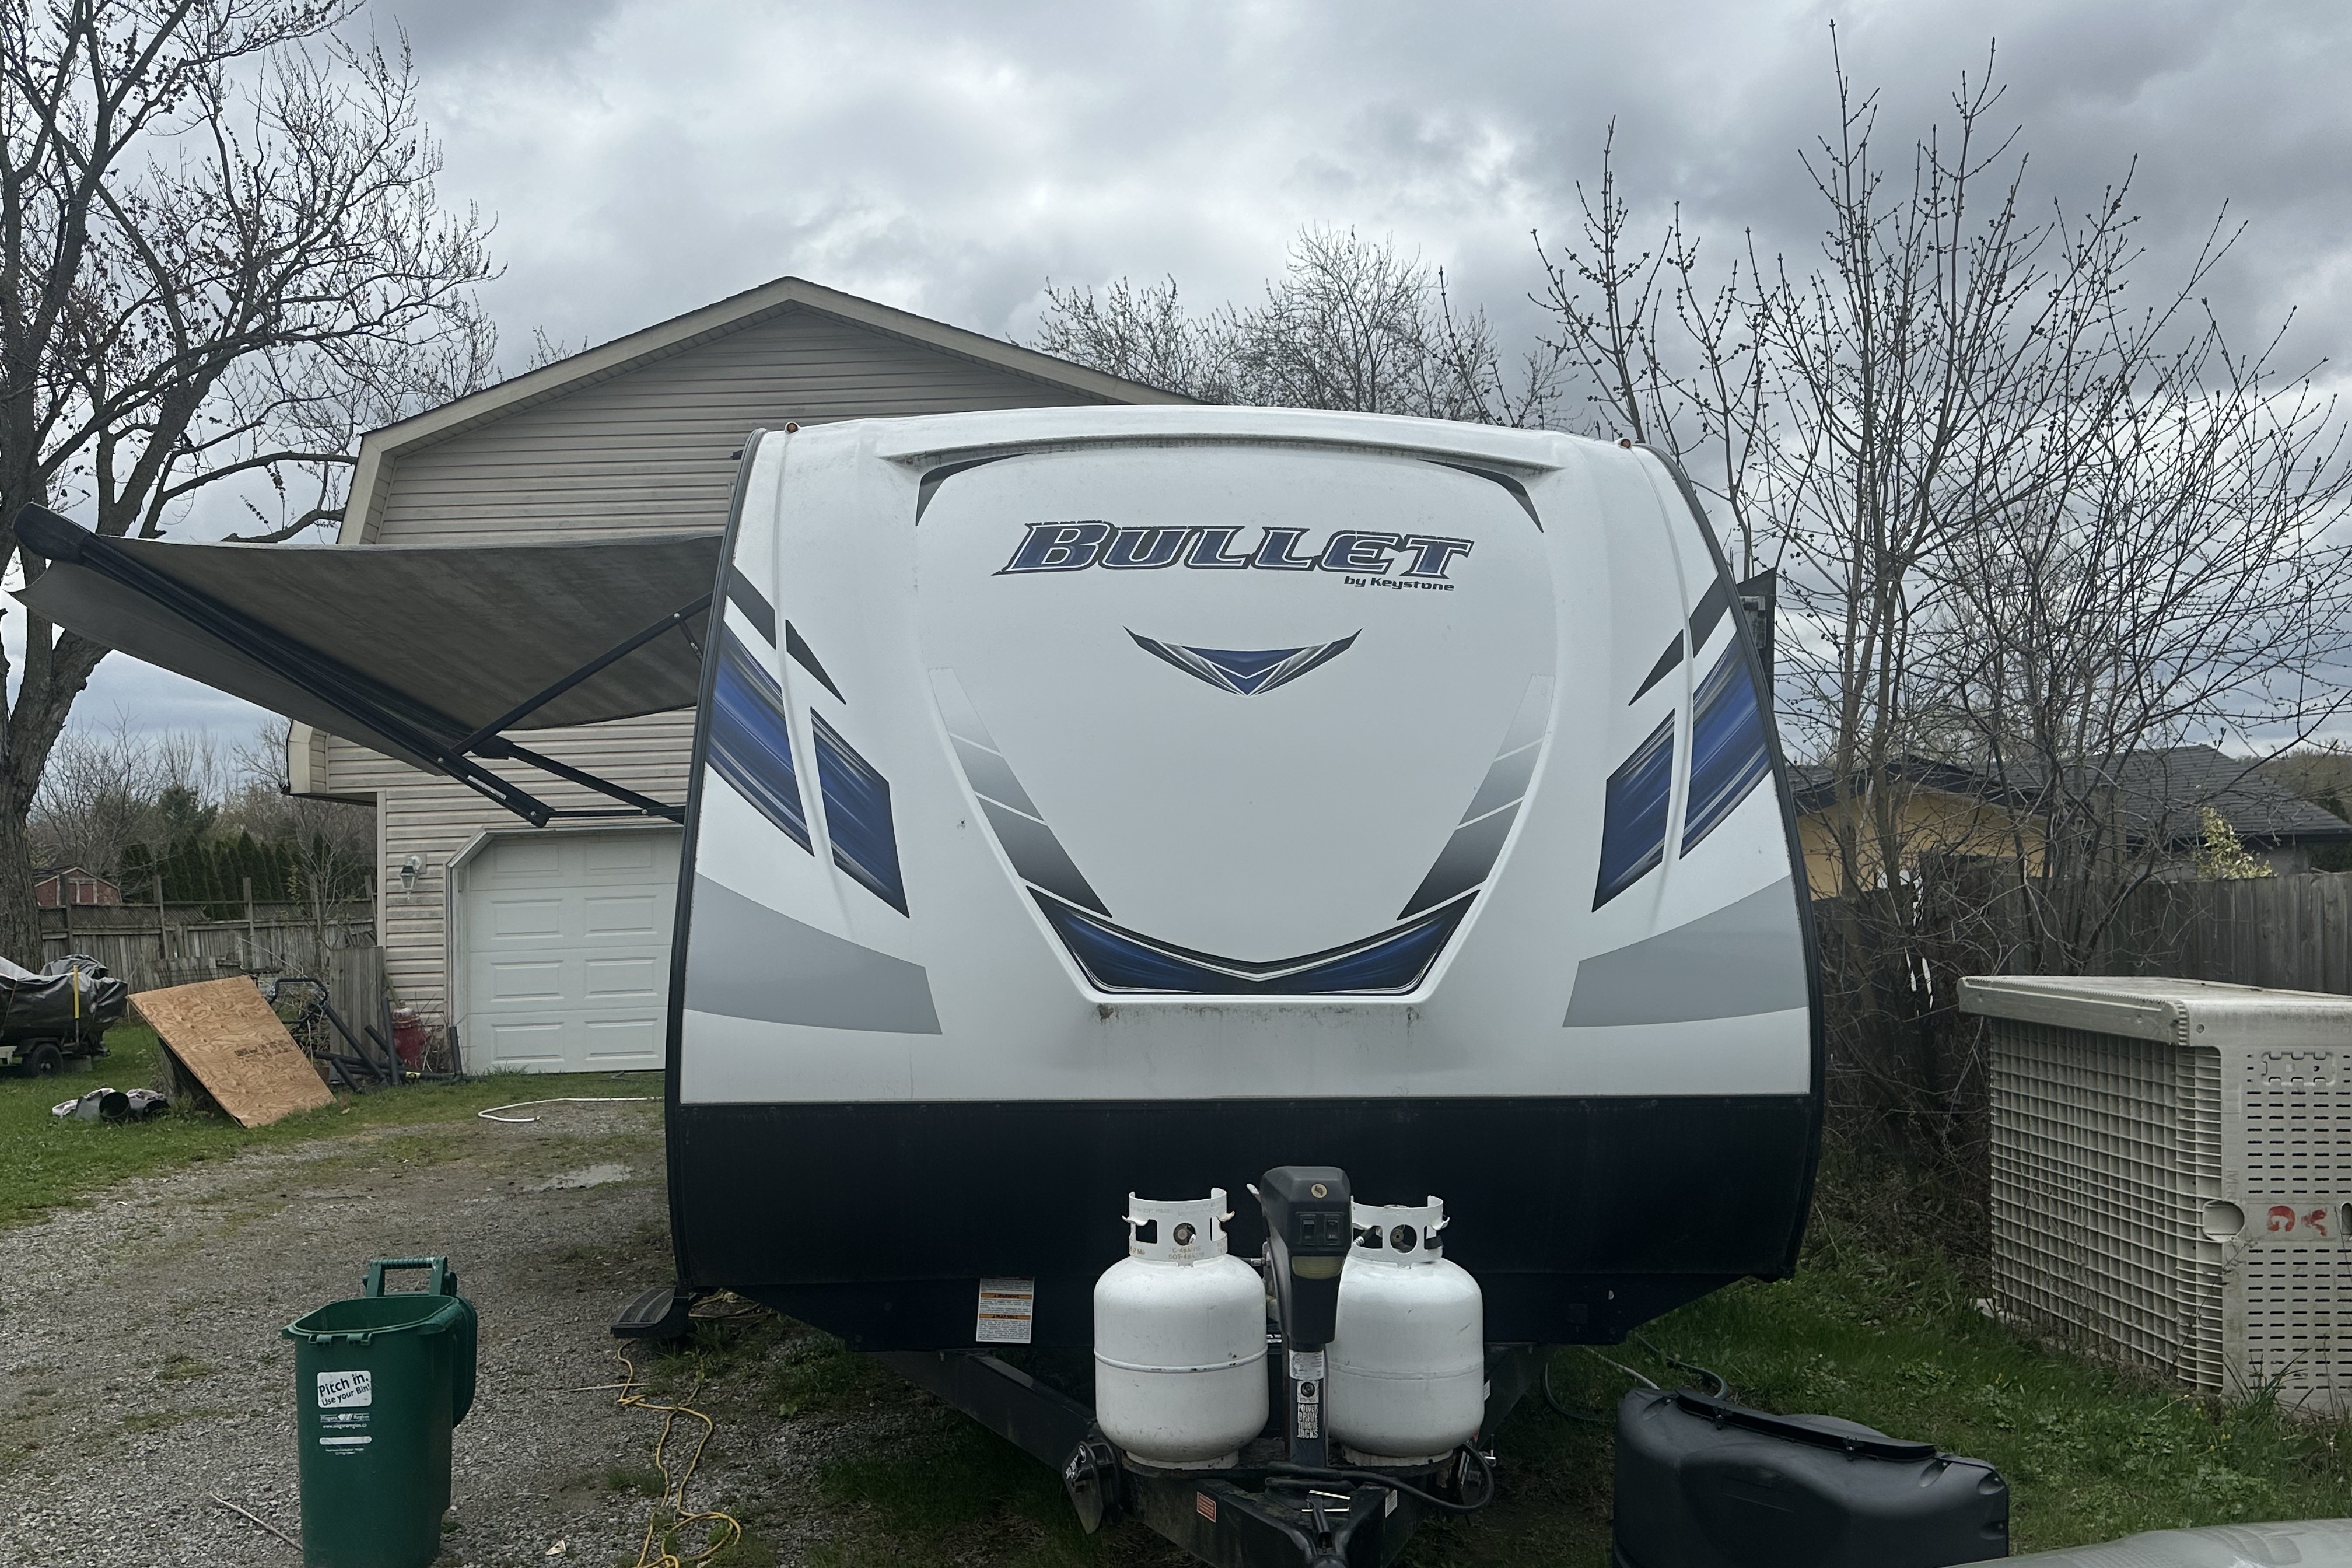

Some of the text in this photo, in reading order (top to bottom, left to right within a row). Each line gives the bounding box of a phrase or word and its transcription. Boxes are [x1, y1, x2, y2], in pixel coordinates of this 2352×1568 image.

[991, 519, 1475, 579] BULLET
[1343, 576, 1454, 592] by Keystone
[318, 1373, 369, 1397] Pitch in.
[321, 1398, 337, 1406] Use
[337, 1390, 354, 1404] your
[1297, 1403, 1318, 1412] POWER
[1297, 1412, 1318, 1422] DRIVE
[1297, 1429, 1318, 1439] JACKS
